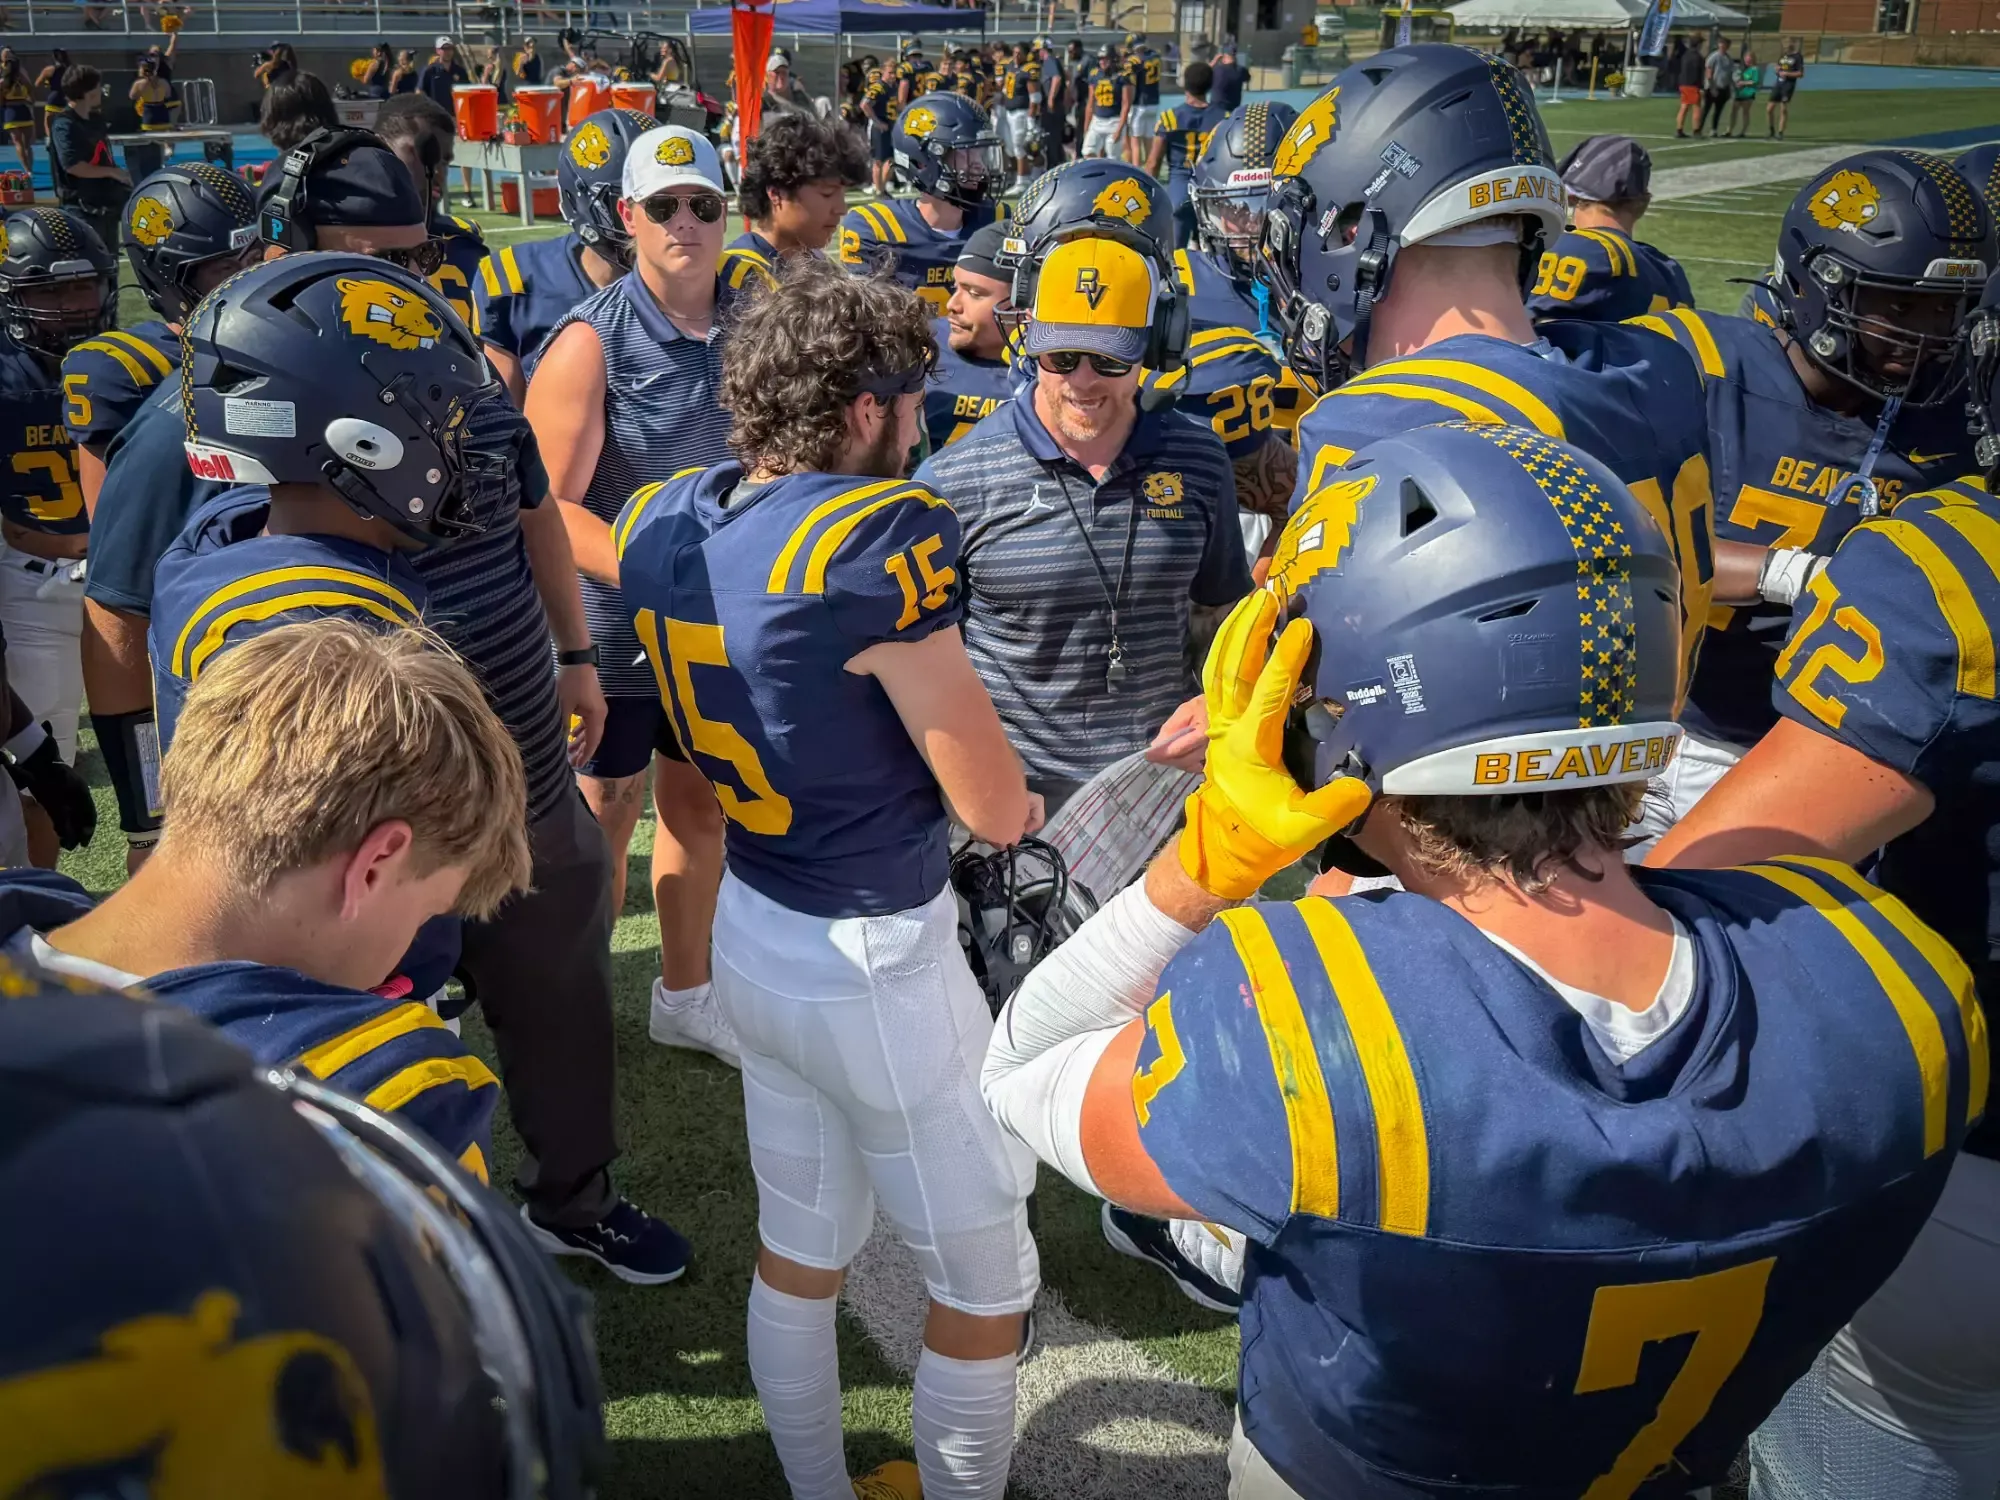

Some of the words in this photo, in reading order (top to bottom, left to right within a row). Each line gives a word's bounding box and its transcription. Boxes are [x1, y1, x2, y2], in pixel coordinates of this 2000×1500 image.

[1233, 172, 1271, 182] Riddell
[1944, 264, 1977, 277] BVU
[64, 374, 92, 426] 5
[1206, 374, 1277, 443] 28
[1146, 508, 1185, 519] FOOTBALL
[885, 533, 956, 631] 15
[1773, 568, 1885, 729] 12
[634, 607, 793, 836] 15
[1574, 1256, 1777, 1500] 7
